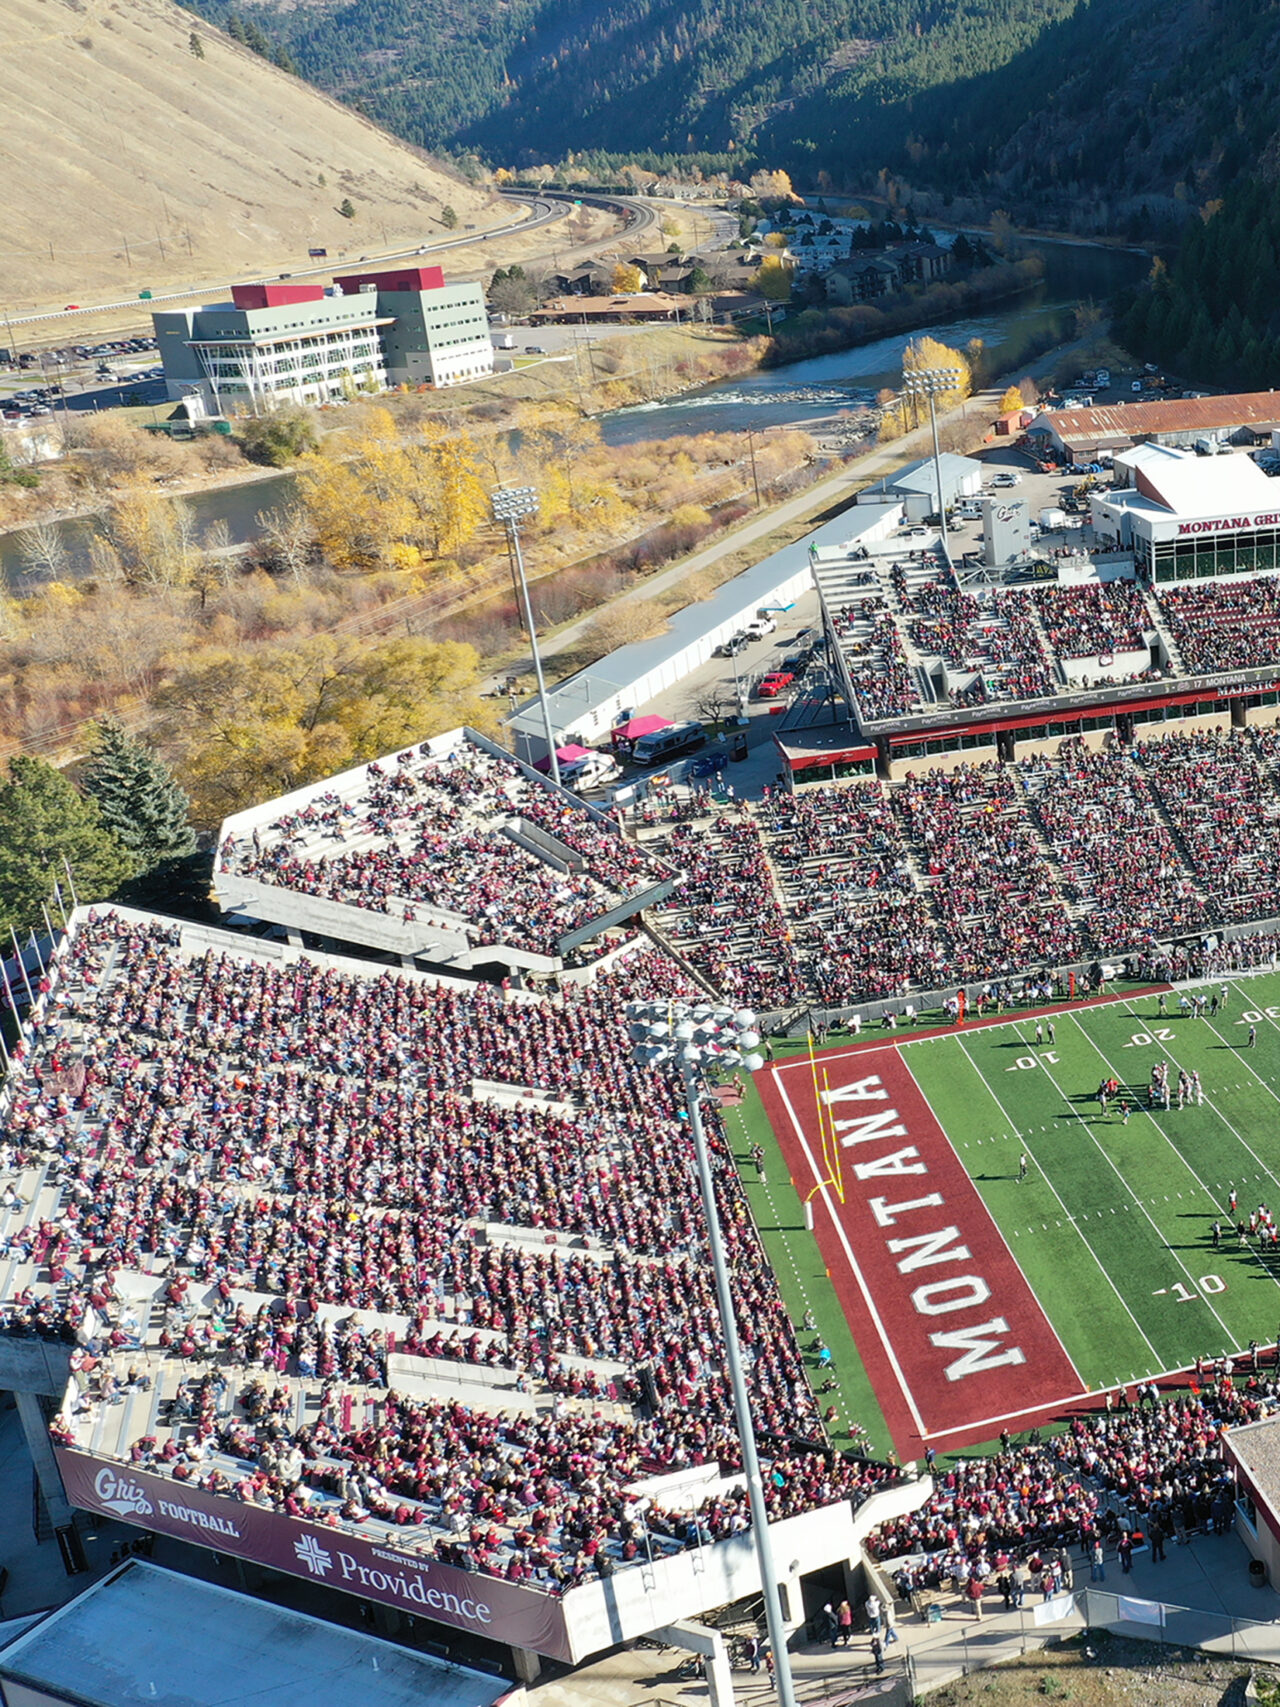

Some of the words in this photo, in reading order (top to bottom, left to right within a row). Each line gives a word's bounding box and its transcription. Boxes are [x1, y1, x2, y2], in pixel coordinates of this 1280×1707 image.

[1178, 517, 1251, 534] MONTANA
[1193, 680, 1202, 689] 17
[1206, 674, 1246, 688] MONTANA
[1217, 679, 1277, 697] MAJESTIC
[1130, 1028, 1176, 1046] 20
[1015, 1051, 1060, 1071] 10
[820, 1074, 1027, 1382] MONTANA
[1169, 1273, 1228, 1303] 10
[94, 1467, 153, 1515] Griz
[158, 1500, 240, 1538] FOOTBALL
[371, 1548, 418, 1568] PRESENTED
[418, 1561, 429, 1572] BY
[337, 1551, 492, 1624] Providence
